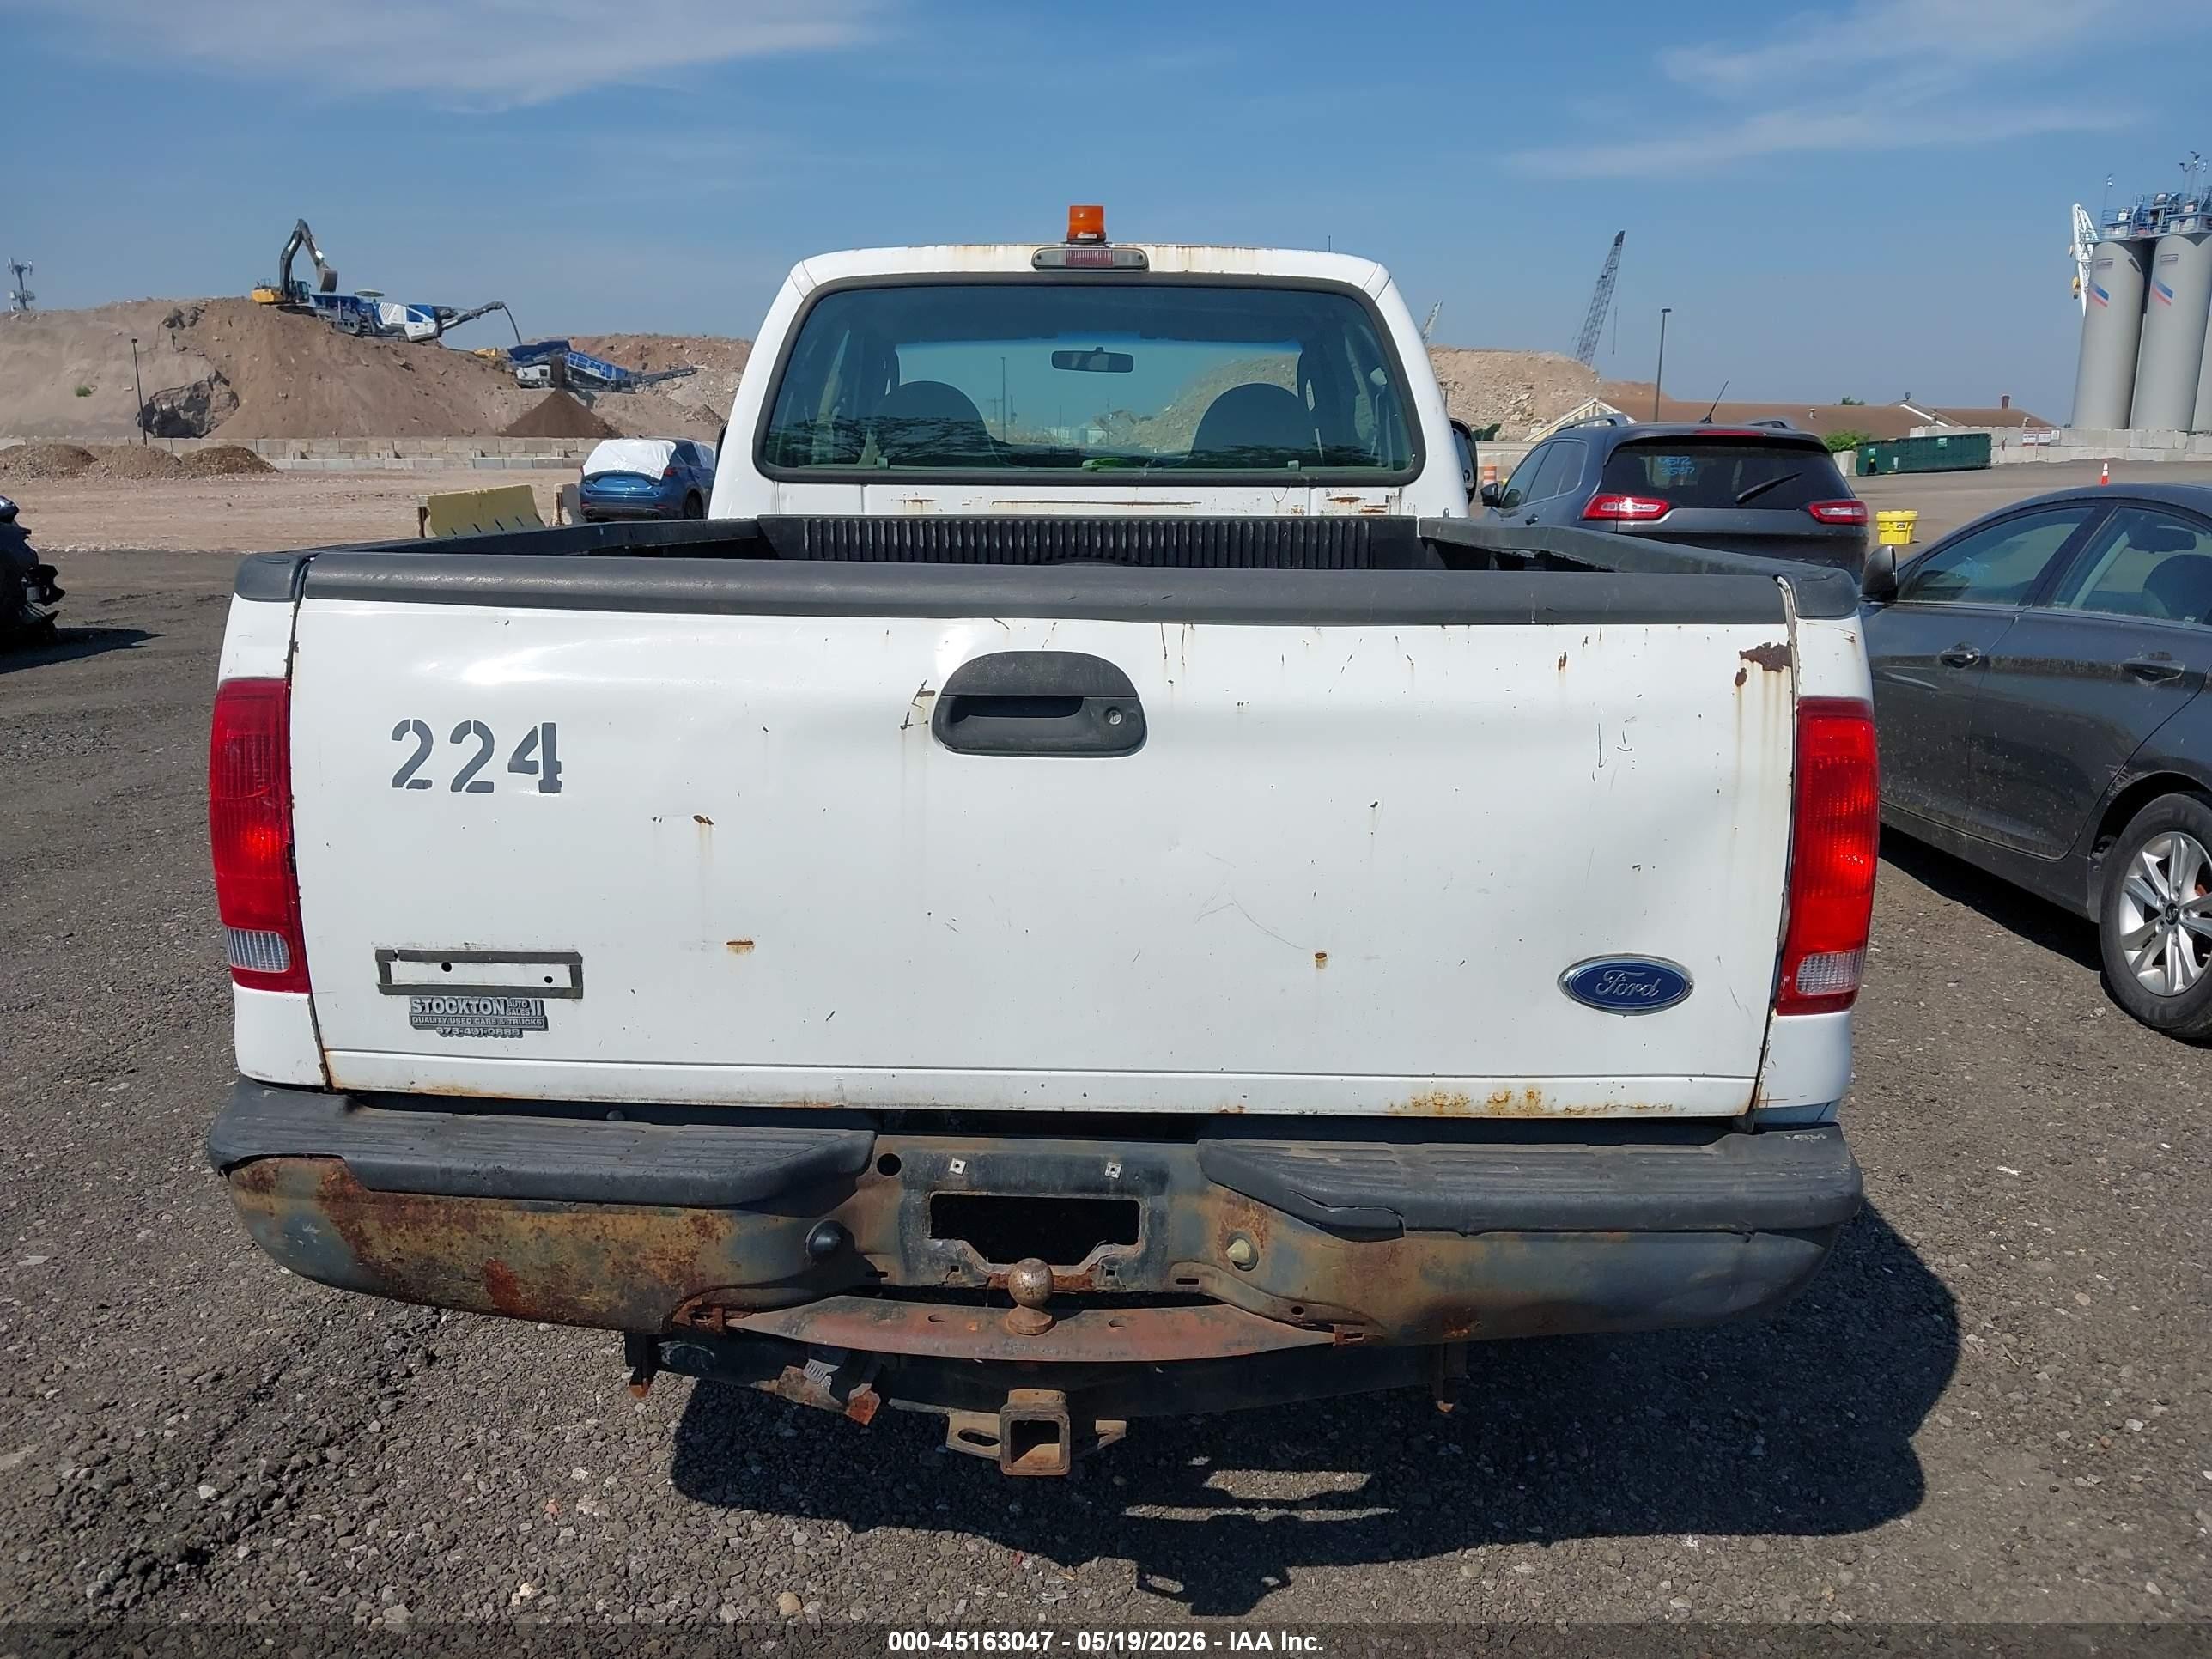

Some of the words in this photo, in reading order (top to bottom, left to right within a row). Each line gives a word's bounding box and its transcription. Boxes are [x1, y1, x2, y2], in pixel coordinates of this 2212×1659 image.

[391, 719, 562, 793] 224
[1595, 969, 1662, 998] Ford
[411, 997, 505, 1015] STOCKTON
[507, 999, 528, 1008] AUTO
[412, 1016, 448, 1024] QUALITY
